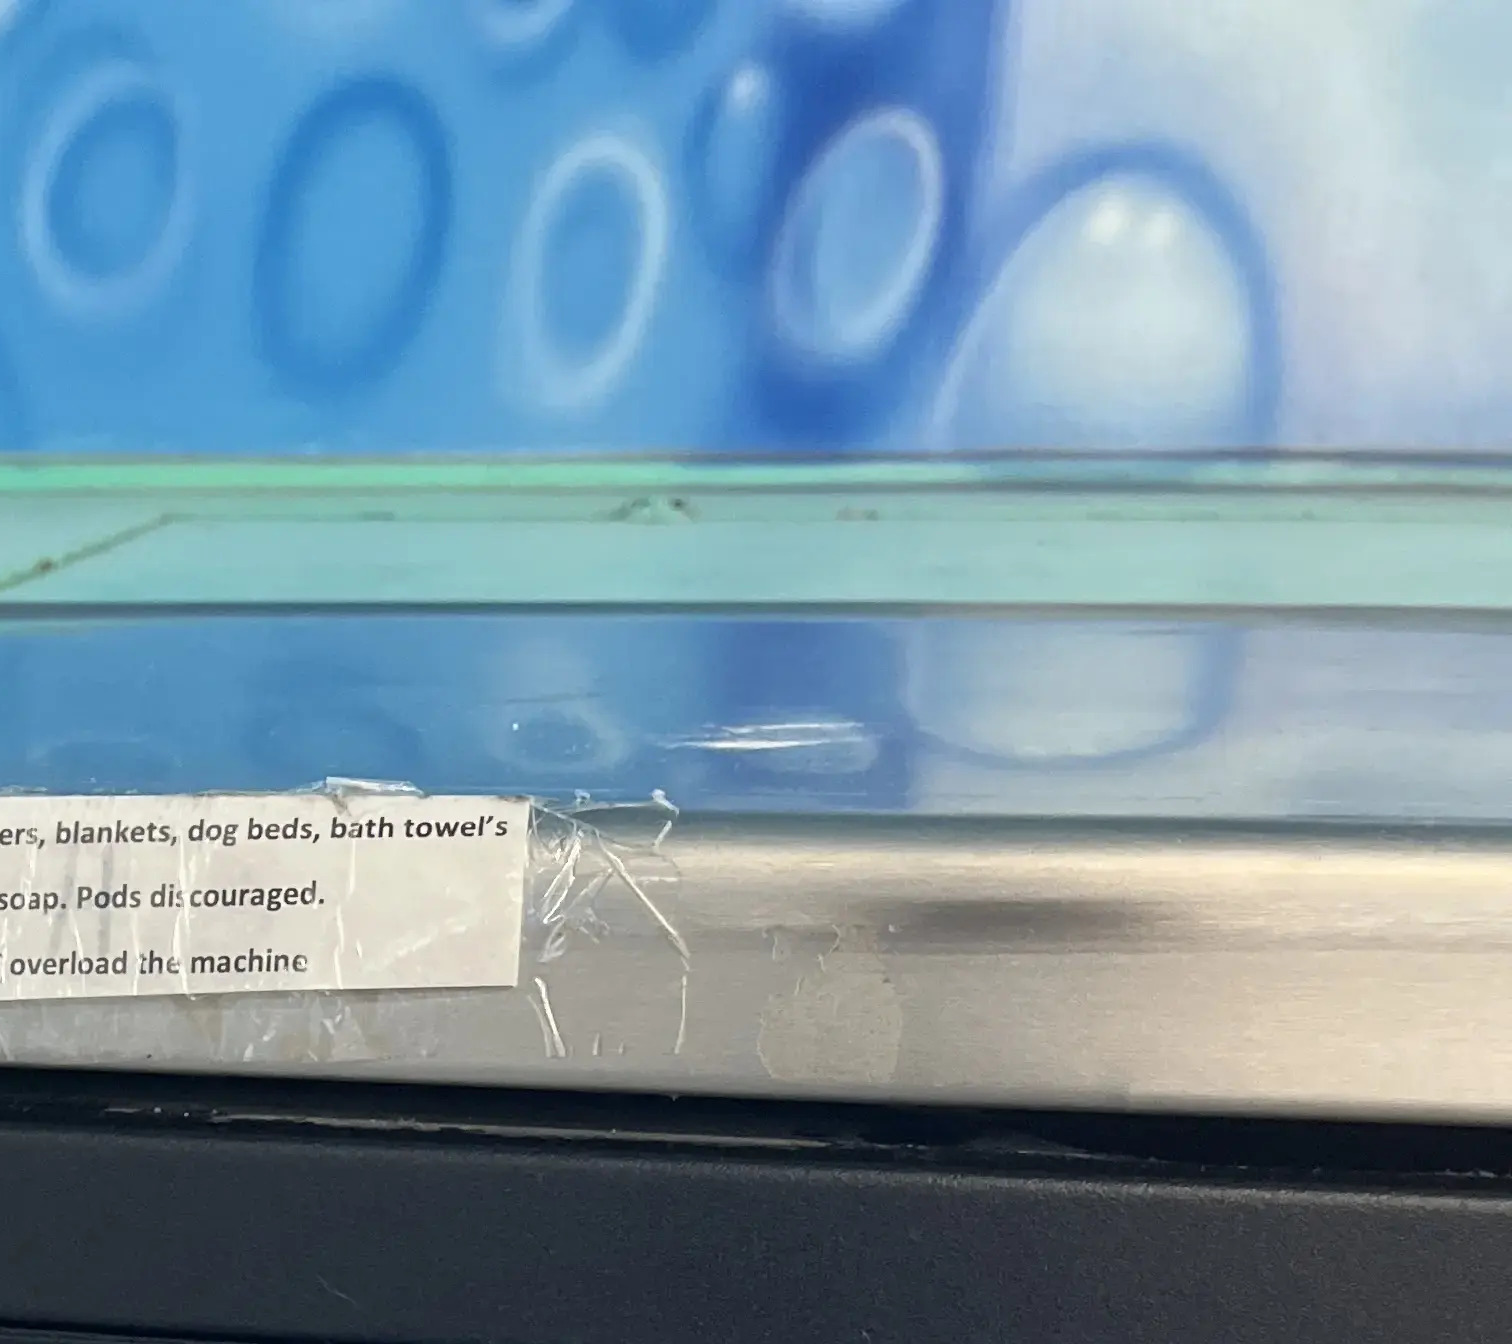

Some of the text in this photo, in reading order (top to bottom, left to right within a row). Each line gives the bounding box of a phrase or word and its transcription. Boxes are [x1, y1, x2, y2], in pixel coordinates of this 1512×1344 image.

[55, 821, 178, 846] blankets,
[188, 819, 238, 846] dog
[247, 818, 321, 843] beds,
[331, 817, 394, 840] bath
[404, 816, 508, 838] towel's
[77, 884, 141, 909] Pods
[10, 950, 128, 979] overload
[139, 951, 181, 974] the
[191, 948, 307, 974] machine
